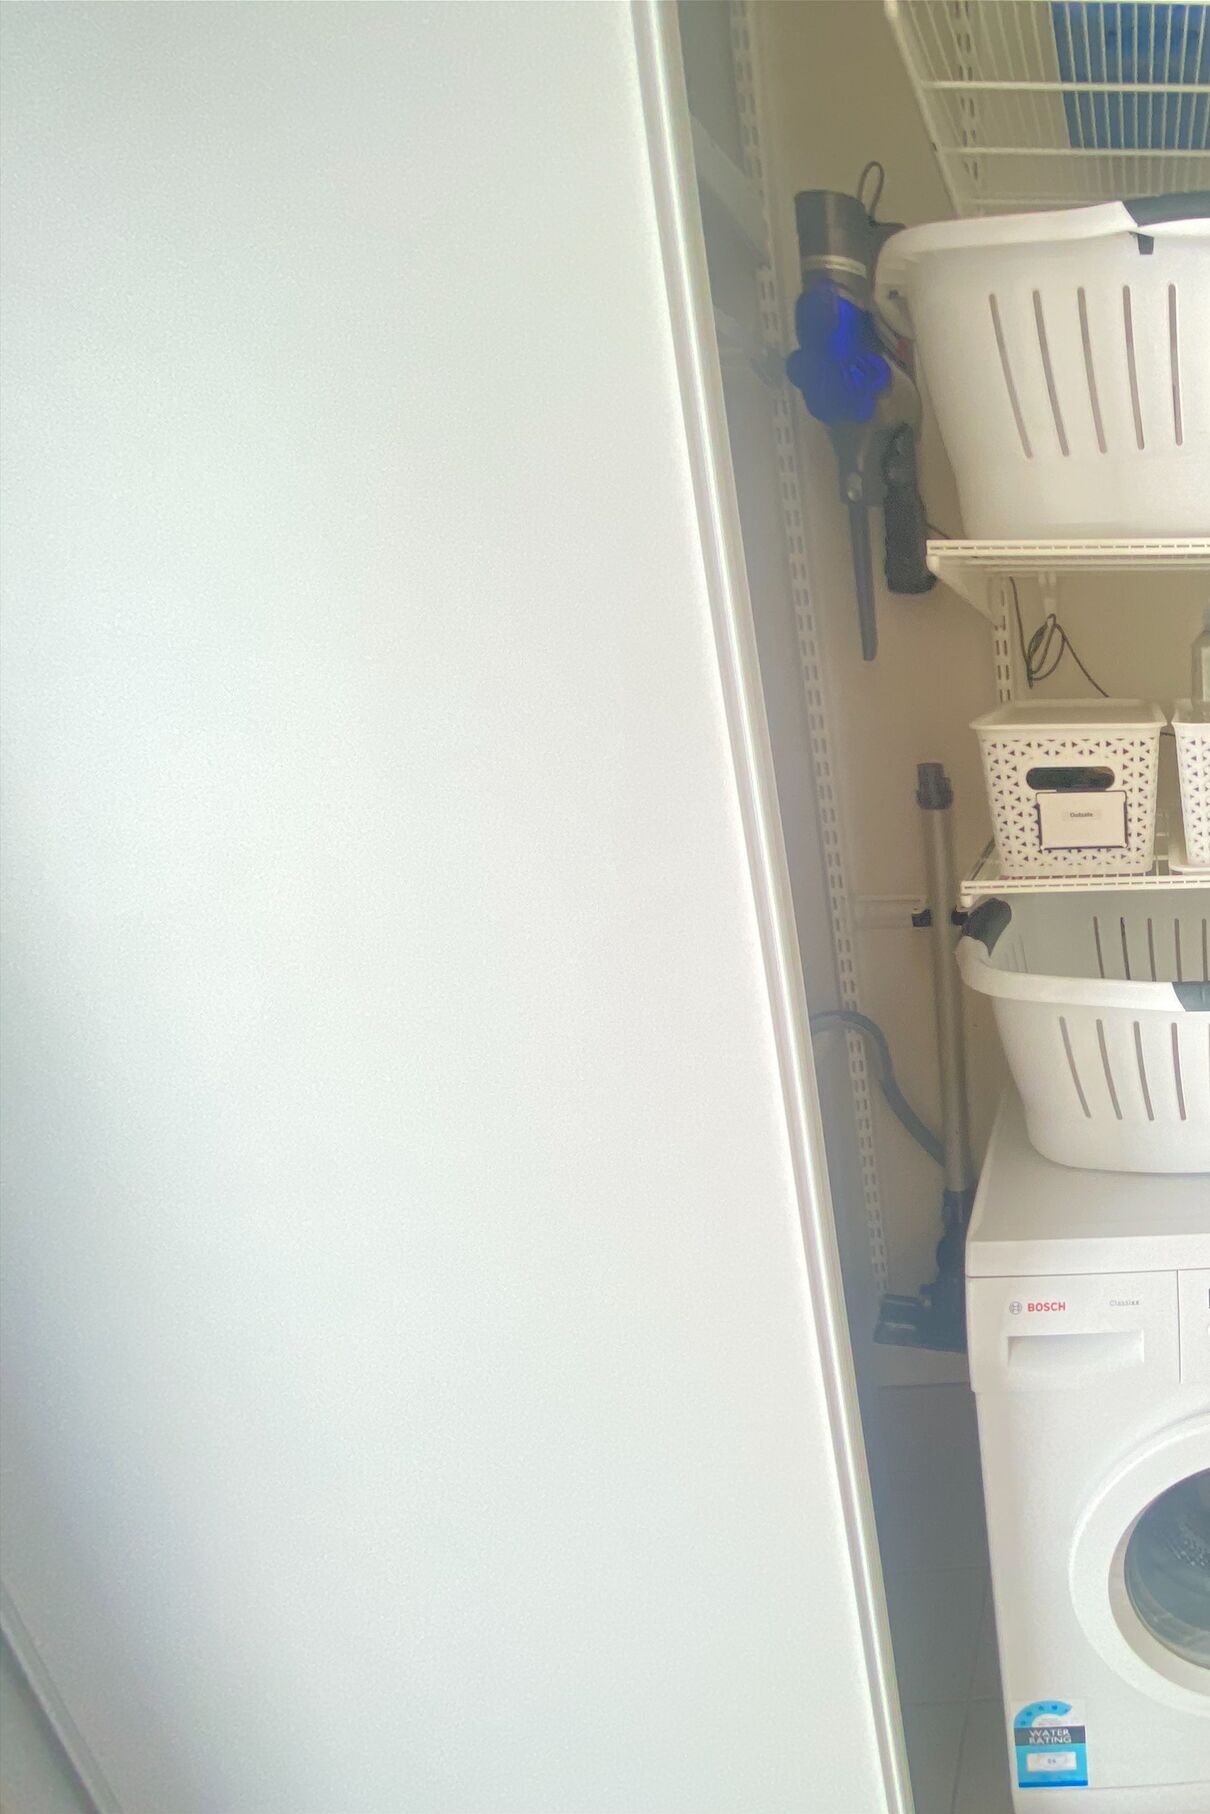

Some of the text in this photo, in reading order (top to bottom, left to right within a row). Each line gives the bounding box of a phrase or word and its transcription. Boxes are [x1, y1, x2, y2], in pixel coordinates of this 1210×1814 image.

[1027, 1301, 1066, 1312] BOSCH
[1029, 1728, 1070, 1737] WATER
[1029, 1736, 1072, 1745] RATING
